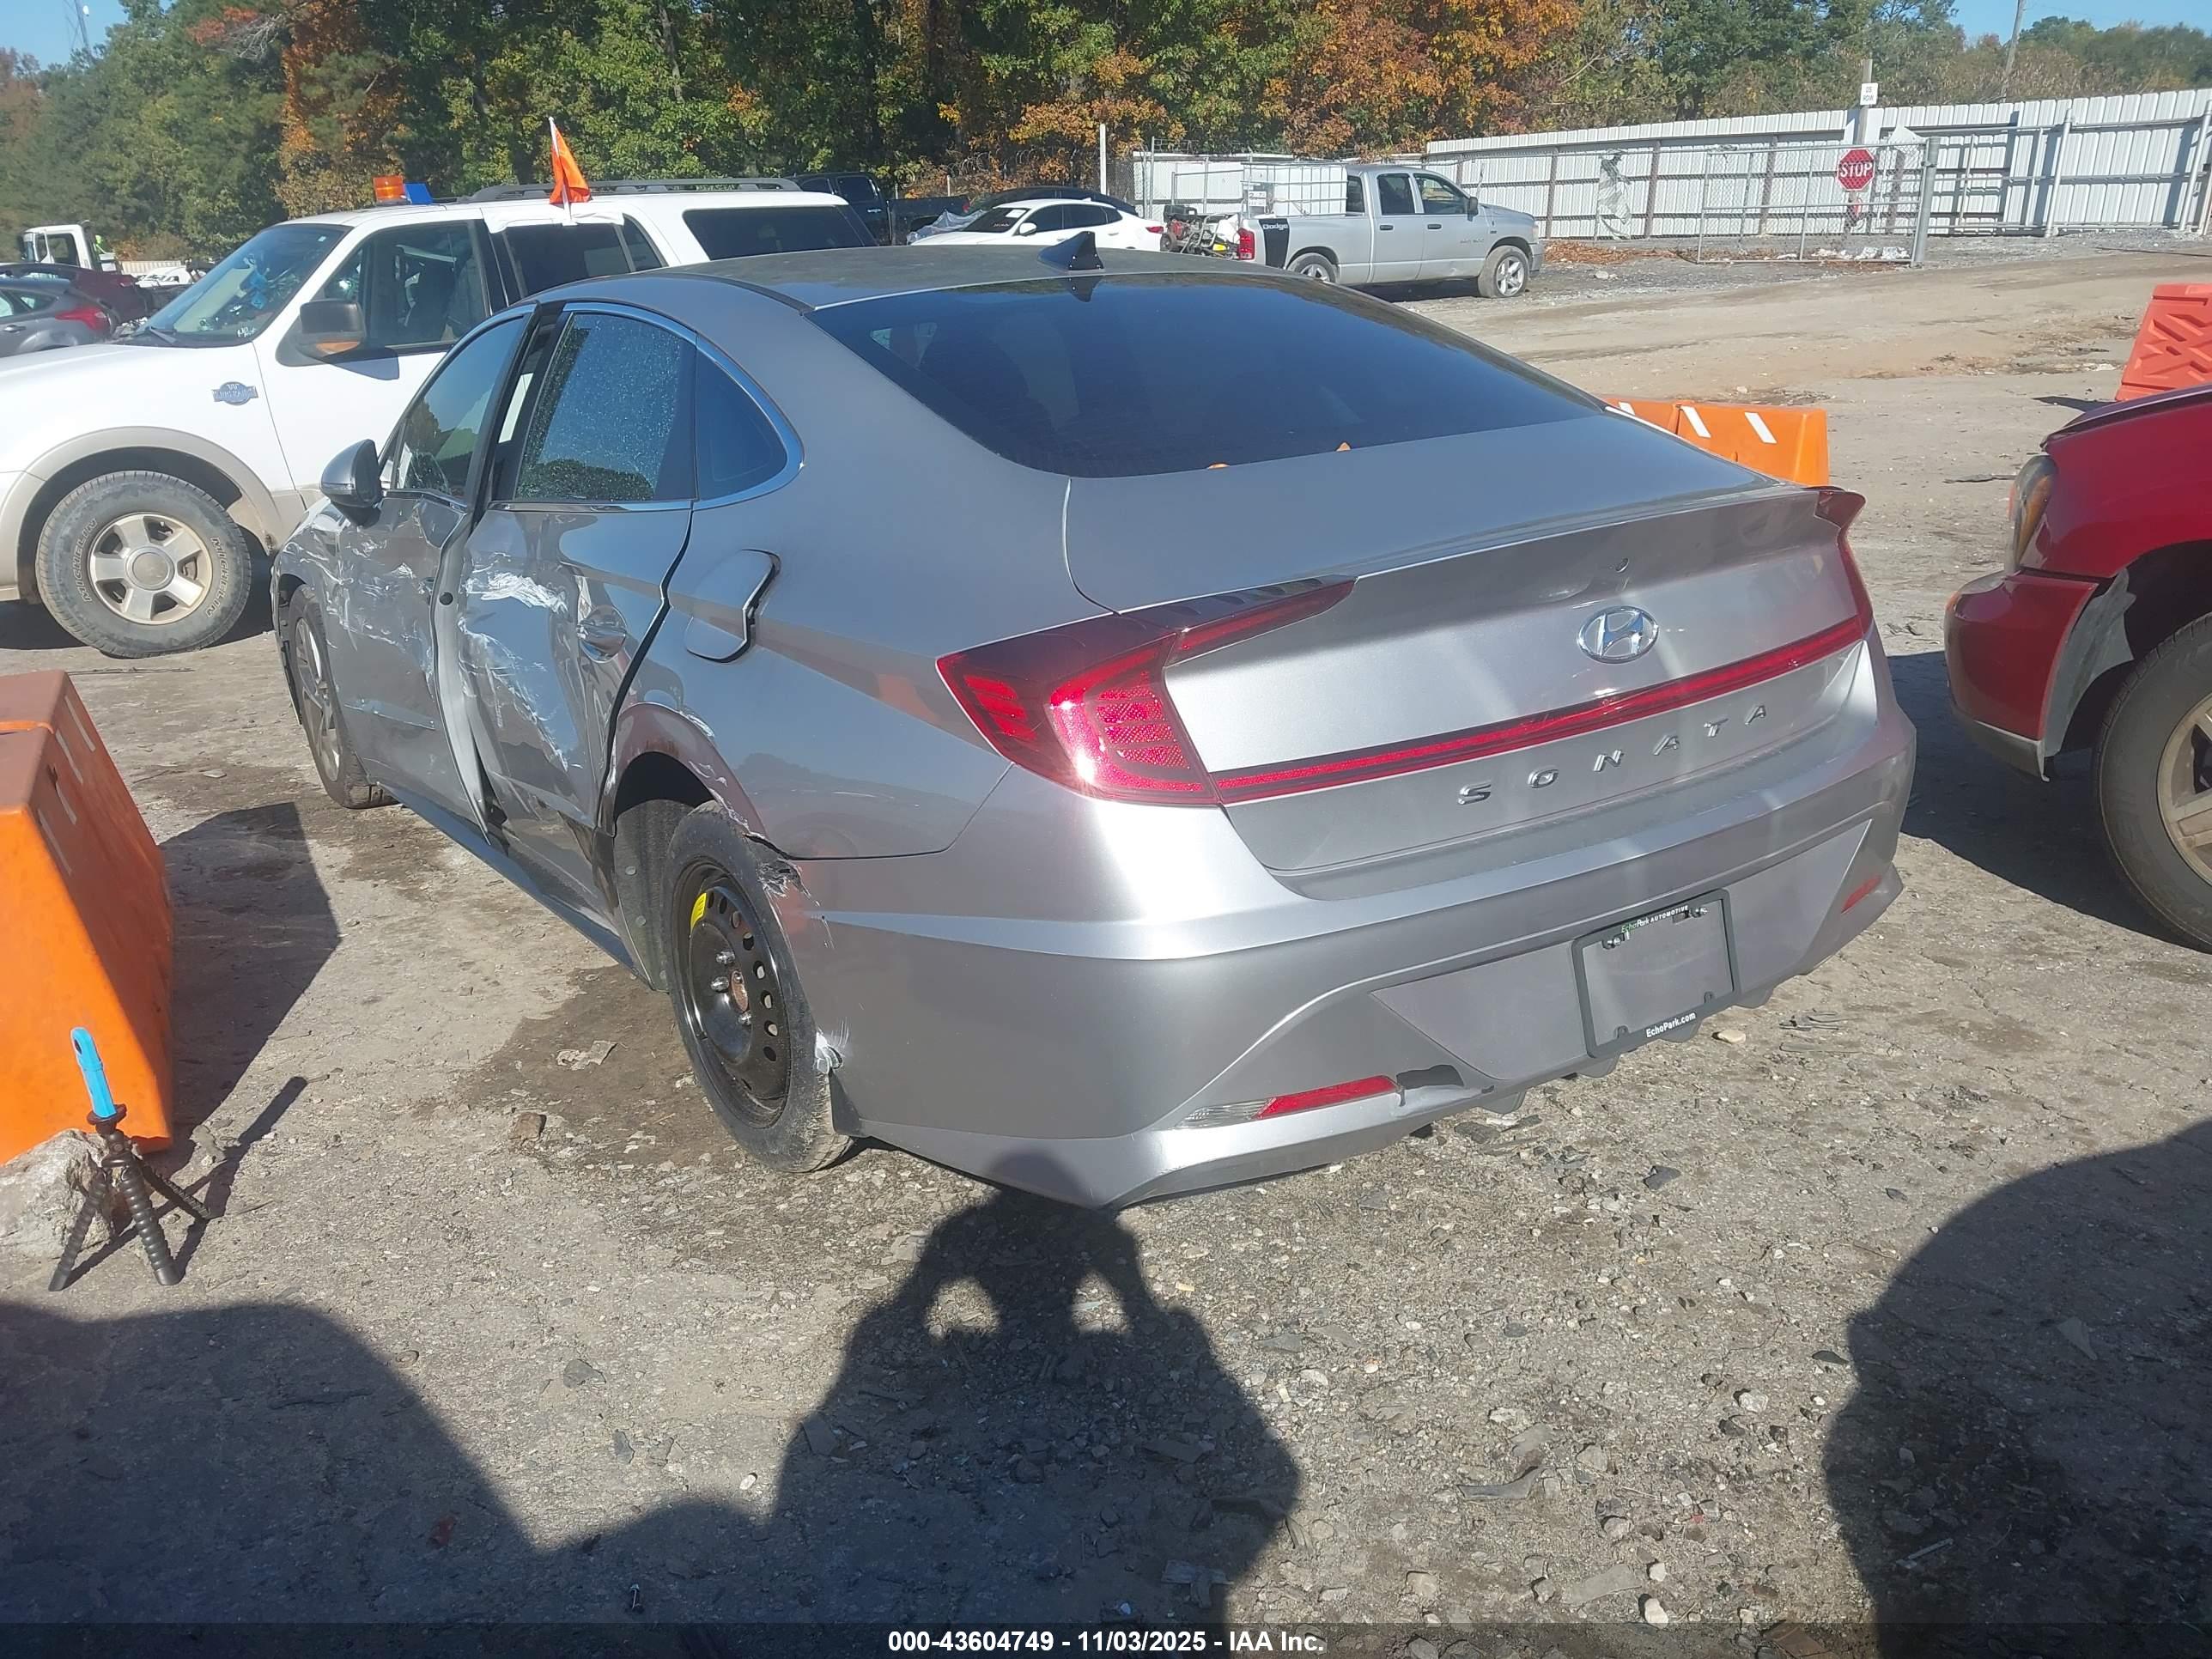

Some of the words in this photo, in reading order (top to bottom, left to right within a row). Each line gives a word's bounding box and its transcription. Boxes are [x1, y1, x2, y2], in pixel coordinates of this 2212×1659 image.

[1839, 161, 1873, 178] STOP
[72, 518, 98, 602] MICHELIN
[206, 537, 229, 618] MICHELIN
[1457, 705, 1767, 805] SONATA
[1650, 905, 1688, 923] AUTOMOTIVE
[1645, 1012, 1696, 1038] EchoPark.com
